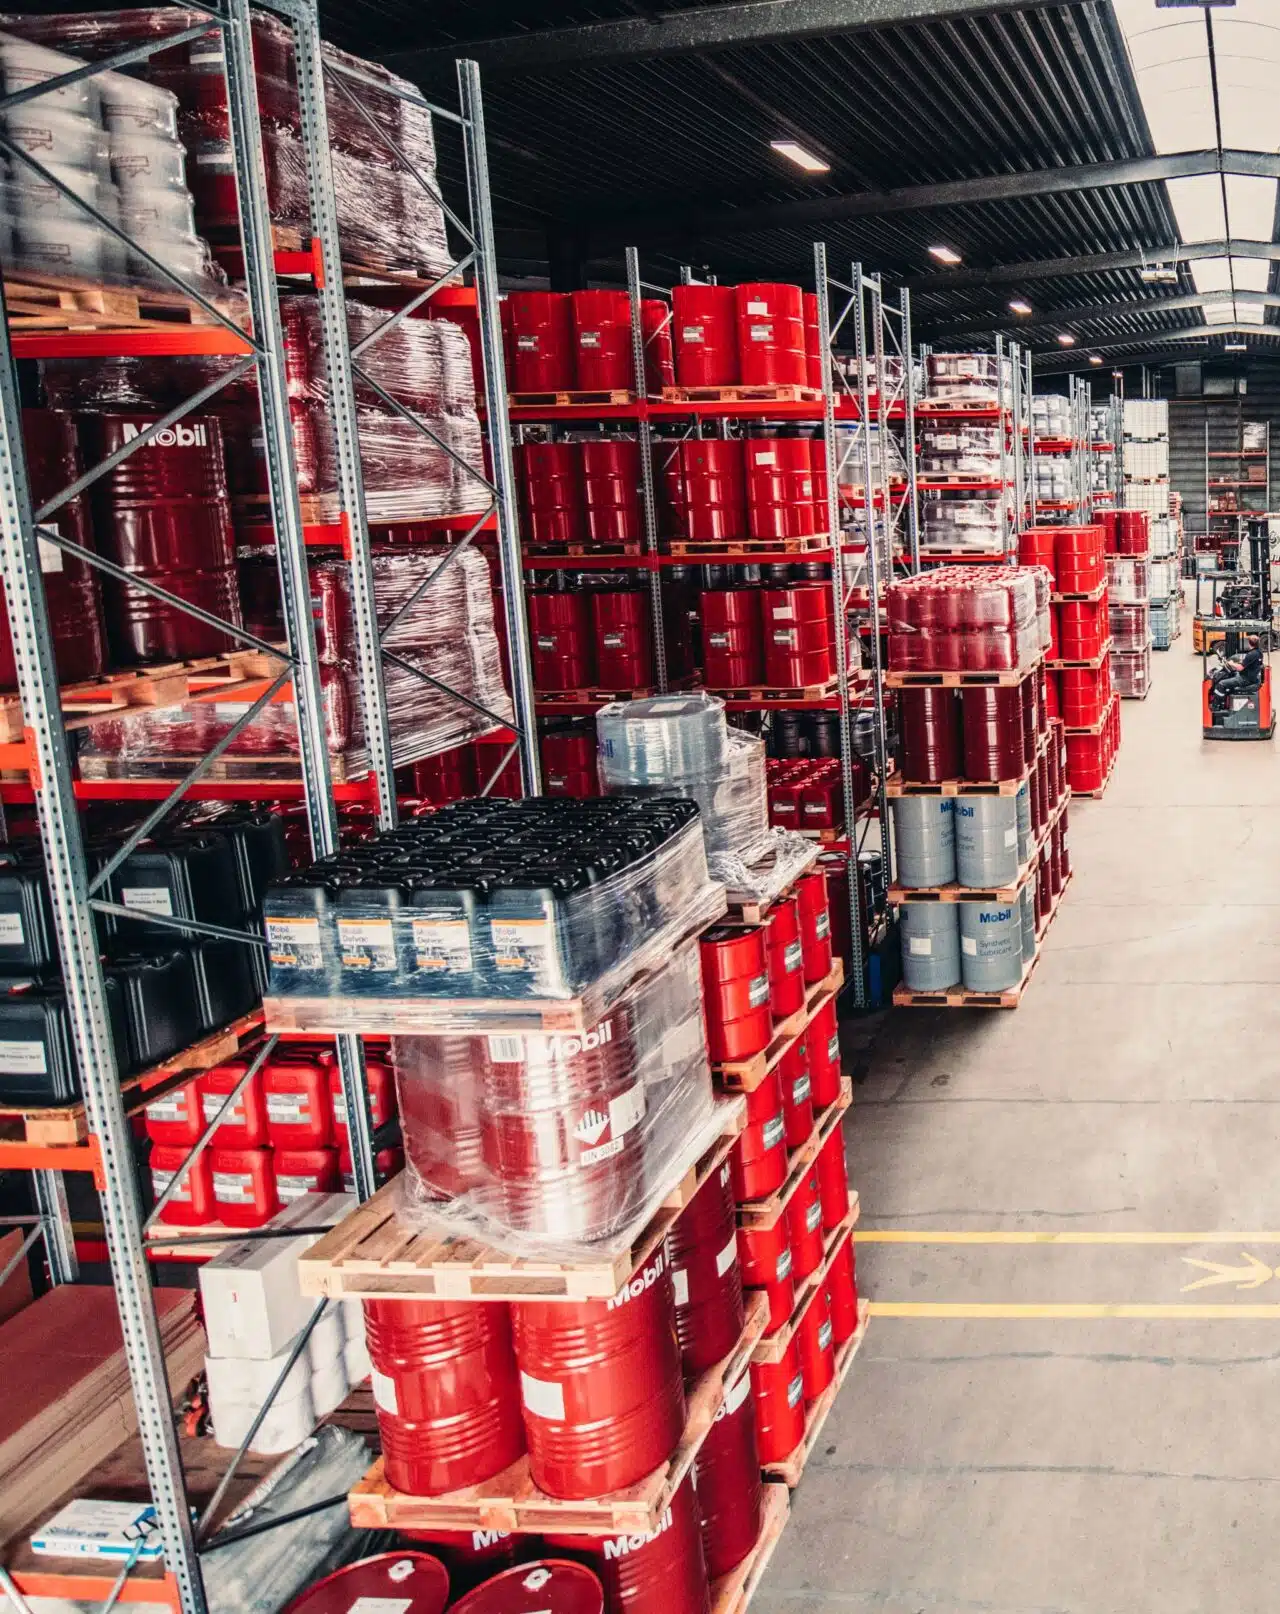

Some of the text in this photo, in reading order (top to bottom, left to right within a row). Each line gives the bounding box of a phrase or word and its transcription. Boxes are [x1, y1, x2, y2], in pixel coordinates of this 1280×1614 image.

[122, 423, 206, 446] Mobil
[955, 806, 974, 817] obil
[979, 909, 1011, 923] Mobil
[607, 1253, 664, 1311] Mobil
[603, 1507, 673, 1560] Mobil
